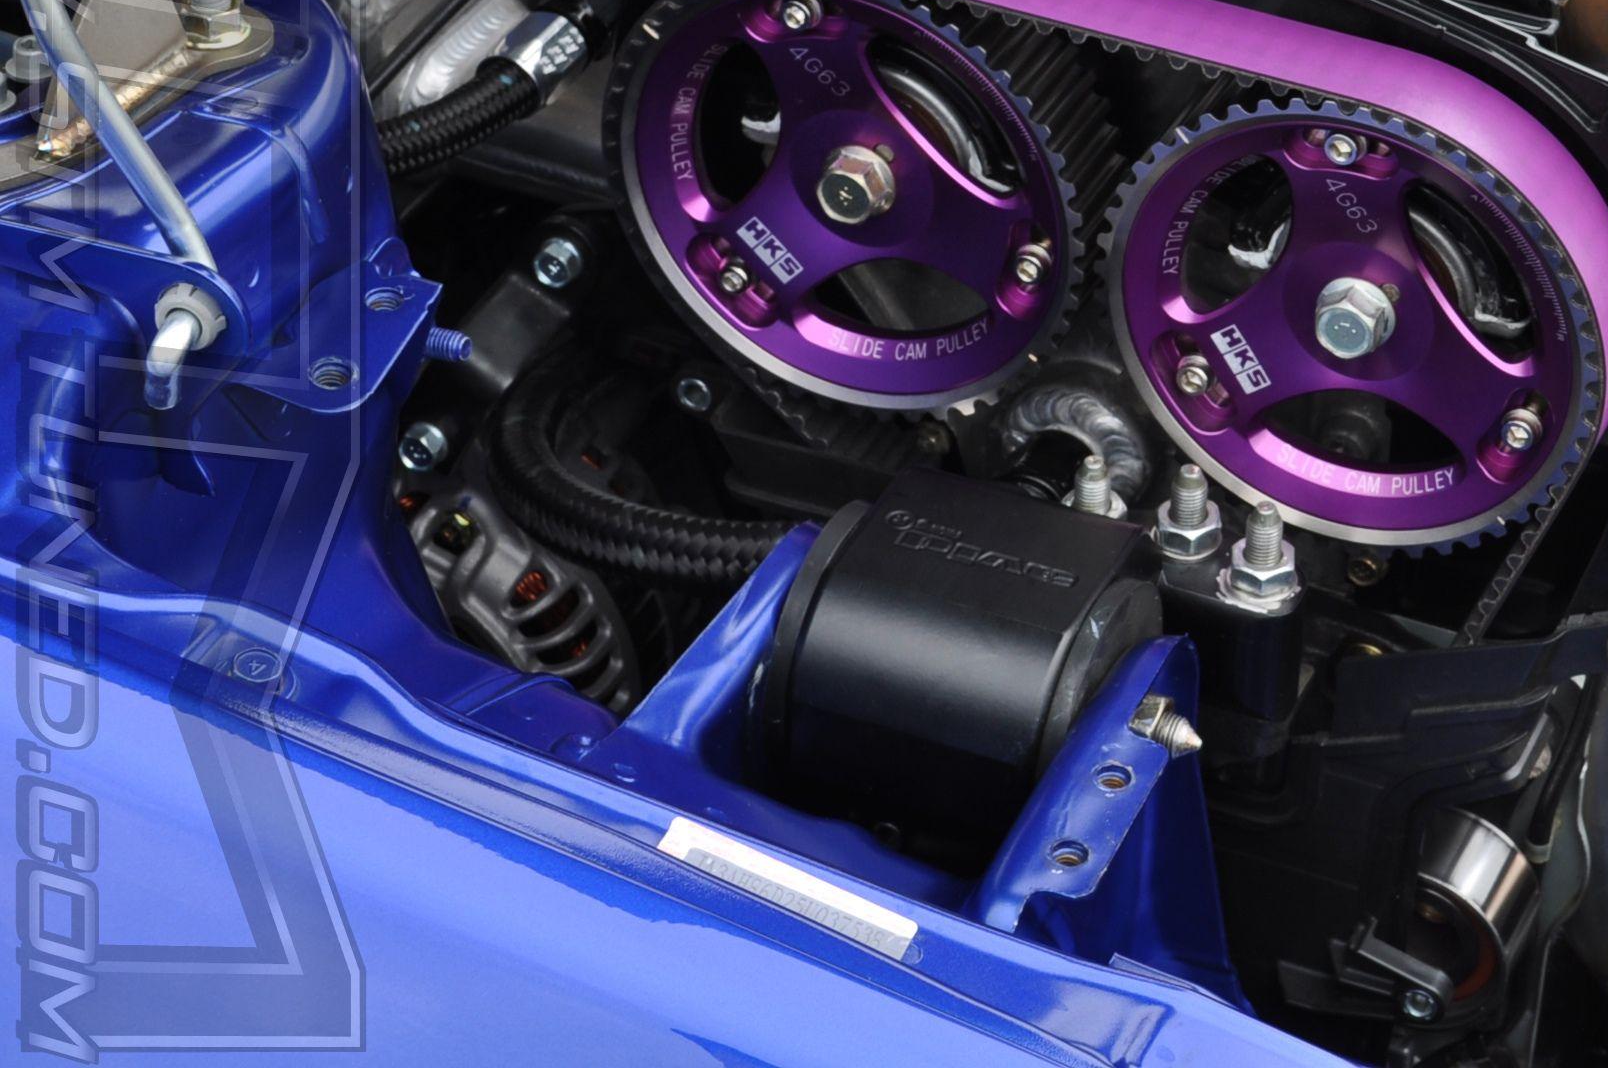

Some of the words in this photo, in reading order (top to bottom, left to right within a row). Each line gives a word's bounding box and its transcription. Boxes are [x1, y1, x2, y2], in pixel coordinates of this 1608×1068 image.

[686, 44, 728, 79] SLIDE
[789, 46, 850, 97] 4G63
[674, 87, 696, 115] CAM
[670, 122, 694, 181] PULLEY
[1179, 189, 1208, 215] CAM
[1325, 177, 1378, 234] 4G63
[737, 217, 804, 284] HKS
[1162, 220, 1189, 275] PULLEY
[827, 329, 883, 359] SLIDE
[894, 342, 927, 360] CAM
[936, 318, 991, 357] PULLEY
[1210, 324, 1271, 394] HKS
[1276, 445, 1332, 484] SLIDE
[1344, 471, 1381, 495] CAM
[1391, 466, 1455, 496] PULLEY
